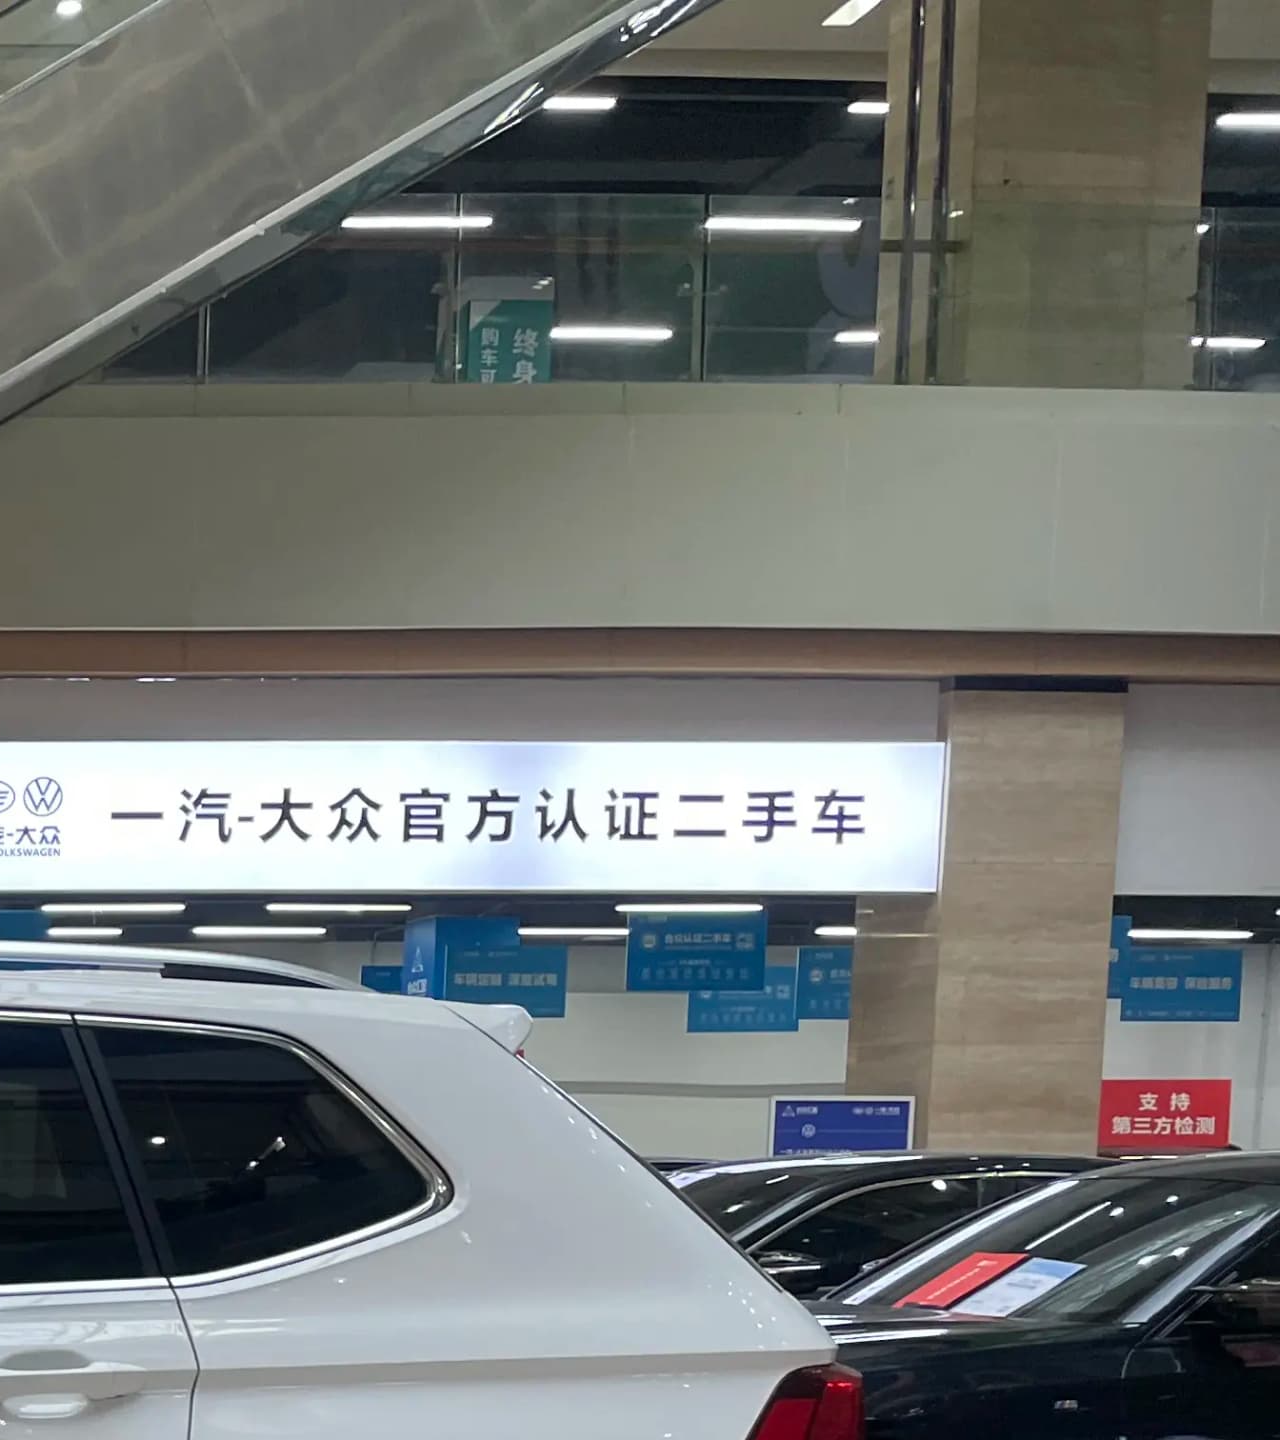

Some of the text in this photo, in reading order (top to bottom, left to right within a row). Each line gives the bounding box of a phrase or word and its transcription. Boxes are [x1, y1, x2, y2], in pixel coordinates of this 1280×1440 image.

[111, 787, 866, 844] 一汽-大众官方认证二手车
[1111, 1116, 1215, 1135] 第三方检测
